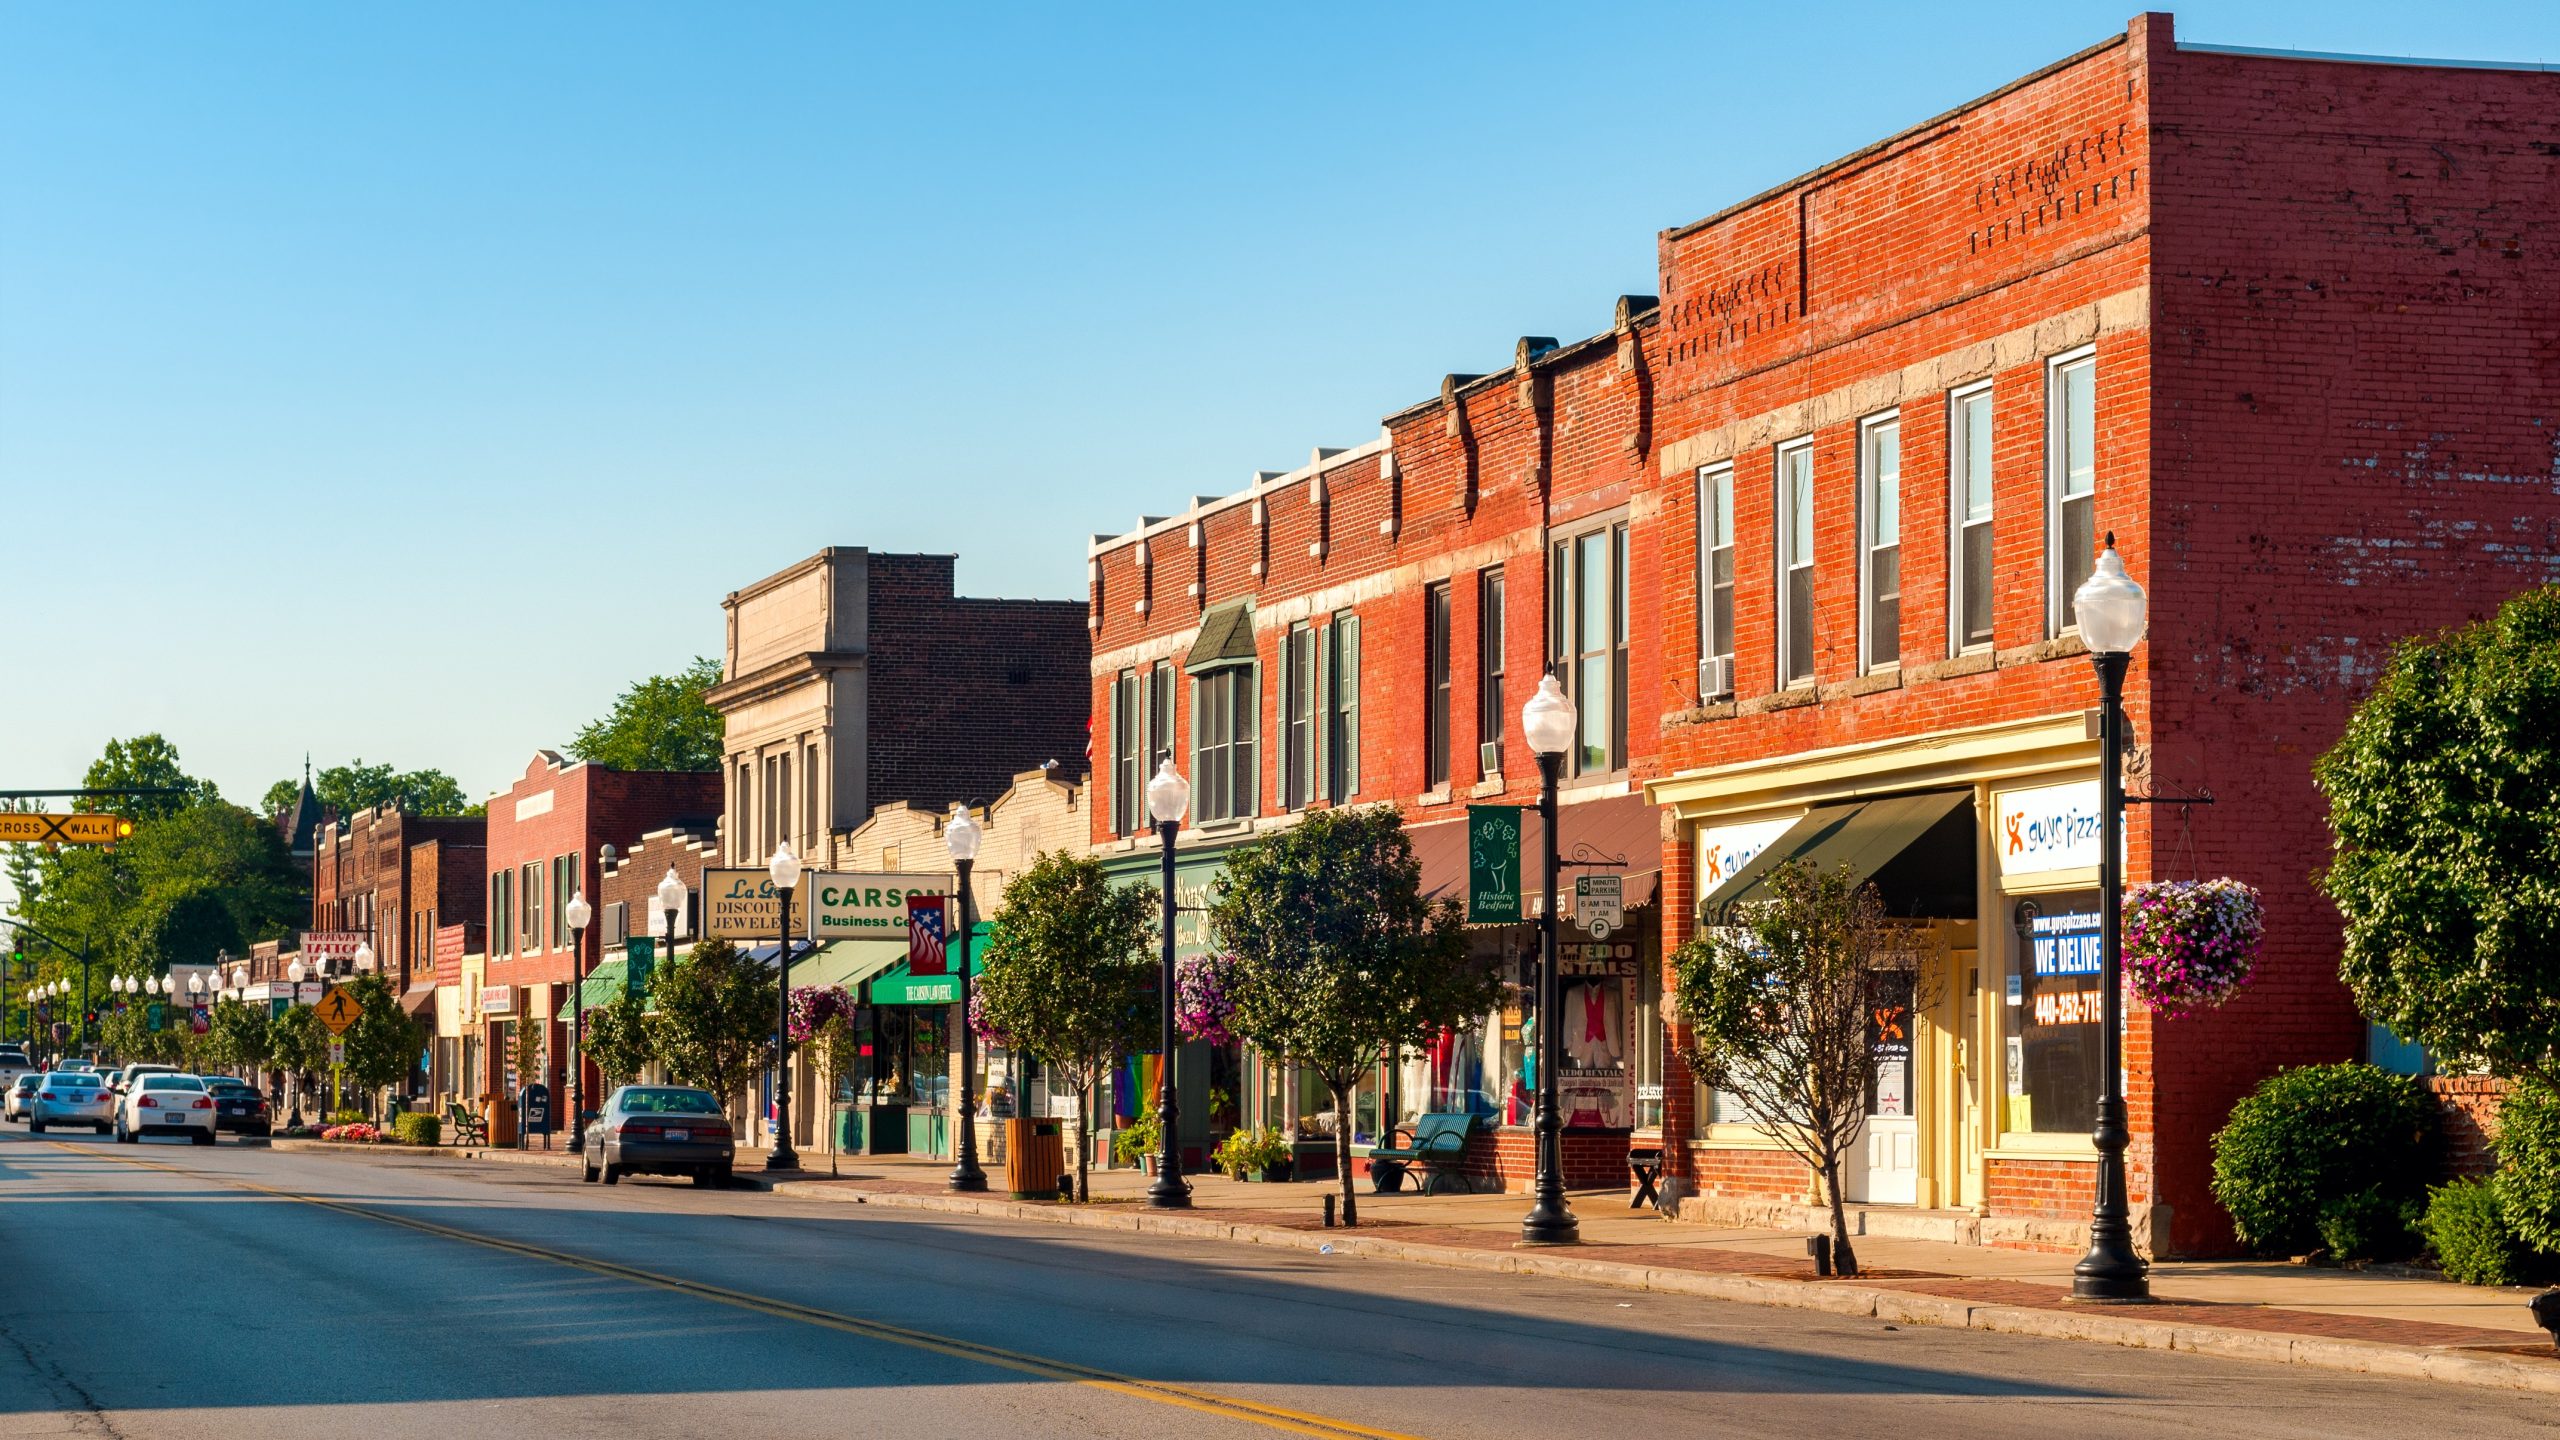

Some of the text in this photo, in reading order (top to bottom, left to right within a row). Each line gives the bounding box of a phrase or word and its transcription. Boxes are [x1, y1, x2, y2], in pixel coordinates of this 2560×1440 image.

[70, 823, 110, 835] WALK
[2028, 816, 2062, 852] guys
[725, 879, 755, 899] La
[1578, 879, 1589, 893] 15
[1478, 891, 1515, 901] Historic
[1478, 901, 1515, 911] Bedford
[713, 917, 802, 930] JEWELES
[821, 915, 889, 927] Business
[1594, 923, 1605, 935] P
[309, 933, 358, 942] BROADWAY
[1557, 944, 1633, 959] XEDO
[2035, 936, 2101, 973] WE DELIVE
[1558, 961, 1637, 976] NTALS
[2035, 991, 2101, 1025] 440-252-715
[1559, 1069, 1583, 1077] XEDO
